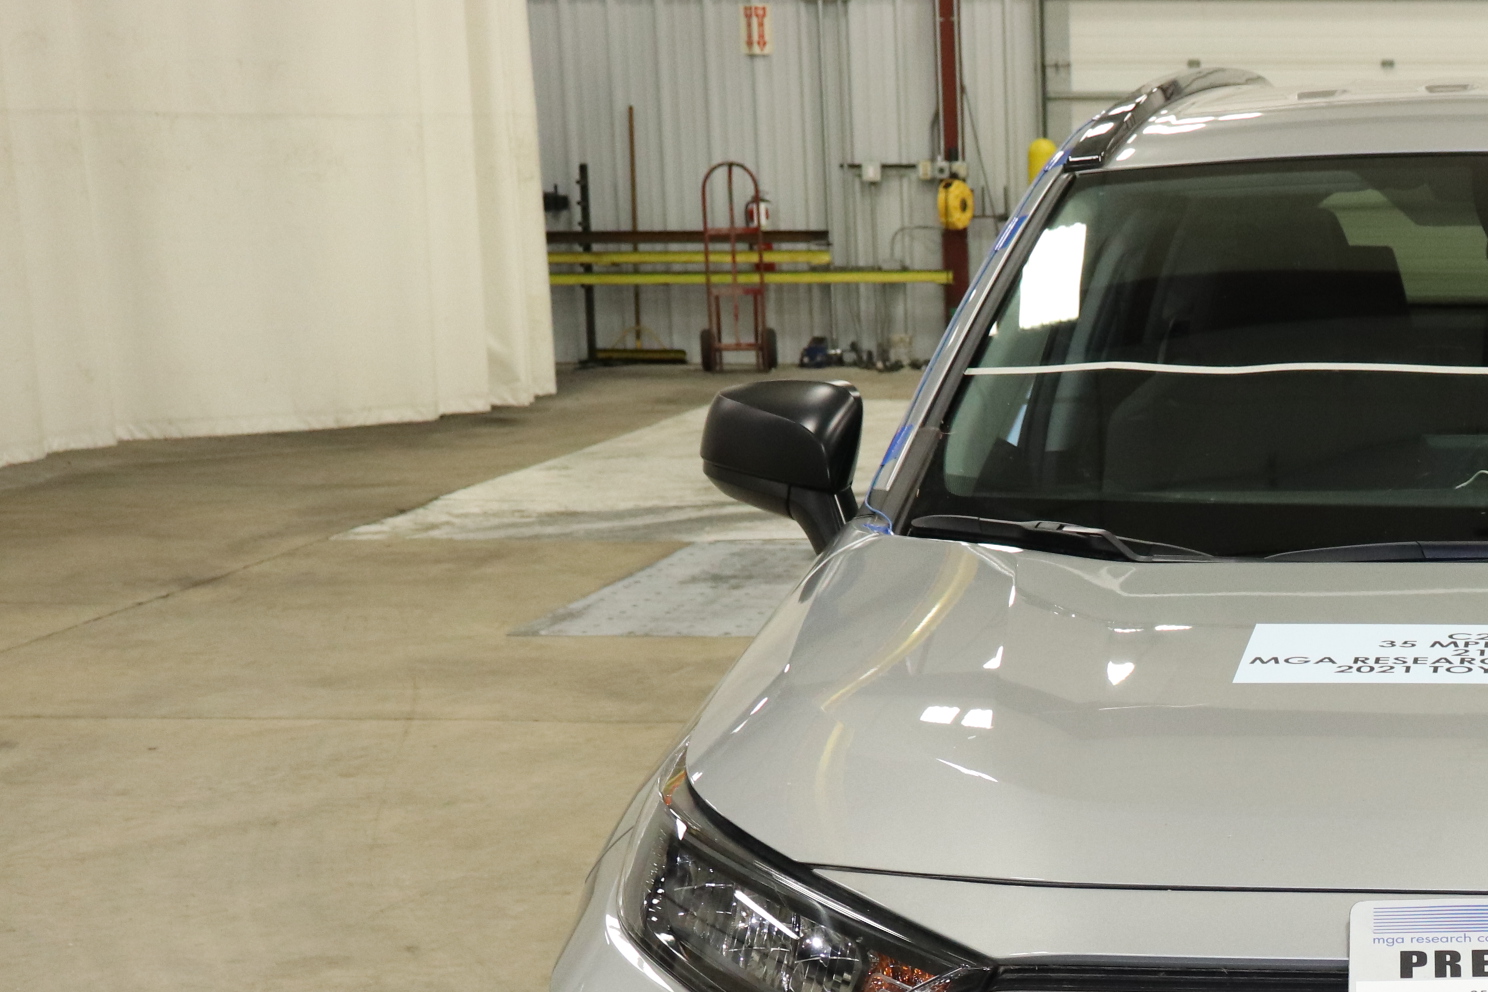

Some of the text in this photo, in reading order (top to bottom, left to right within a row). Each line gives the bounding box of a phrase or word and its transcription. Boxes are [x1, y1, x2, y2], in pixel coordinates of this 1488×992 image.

[1379, 640, 1418, 648] 35
[1249, 656, 1338, 665] MGA
[1334, 665, 1411, 674] 2021
[1373, 936, 1404, 947] mga
[1410, 932, 1472, 945] research
